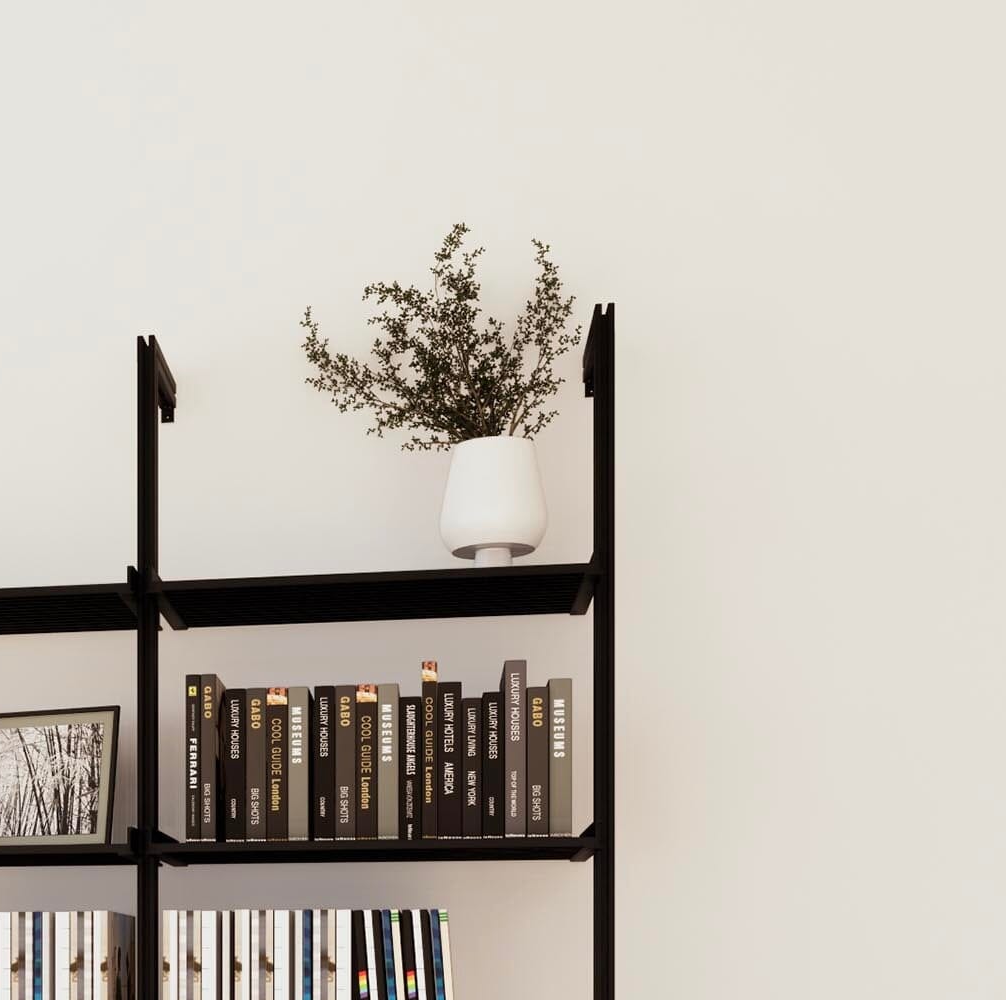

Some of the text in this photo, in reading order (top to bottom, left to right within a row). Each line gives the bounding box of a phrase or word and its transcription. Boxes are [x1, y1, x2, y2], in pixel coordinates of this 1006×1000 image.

[204, 686, 212, 718] GABO
[251, 699, 261, 729] GABO
[340, 696, 351, 727] GABO
[444, 693, 454, 753] LUXURY HOTELS
[511, 673, 520, 742] LUXURY HOUSES
[532, 697, 543, 727] GABO
[231, 699, 239, 759] LUXURY HOUSES
[292, 707, 302, 764] MUSEUMS
[320, 697, 328, 758] LUXURY HOUSES
[382, 704, 392, 762] MUSEUMS
[406, 704, 416, 753] SLAUGHTERHOUSE
[425, 697, 433, 804] COOL GUIDE London
[467, 707, 476, 757] LUXURY LIVING
[489, 702, 498, 759] LUXURY HOUSES
[554, 699, 565, 758] MUSEUMS
[189, 738, 197, 789] FERRARI
[271, 718, 282, 811] COOL GUIDE London
[361, 715, 372, 809] COOL GUIDE London
[406, 754, 416, 775] ANGELS
[444, 761, 454, 795] AMERICA
[251, 788, 259, 825] BIG SHOTS
[340, 786, 349, 823] BIG SHOTS
[467, 770, 476, 806] NEW YORK
[532, 785, 542, 821] BIG SHOTS
